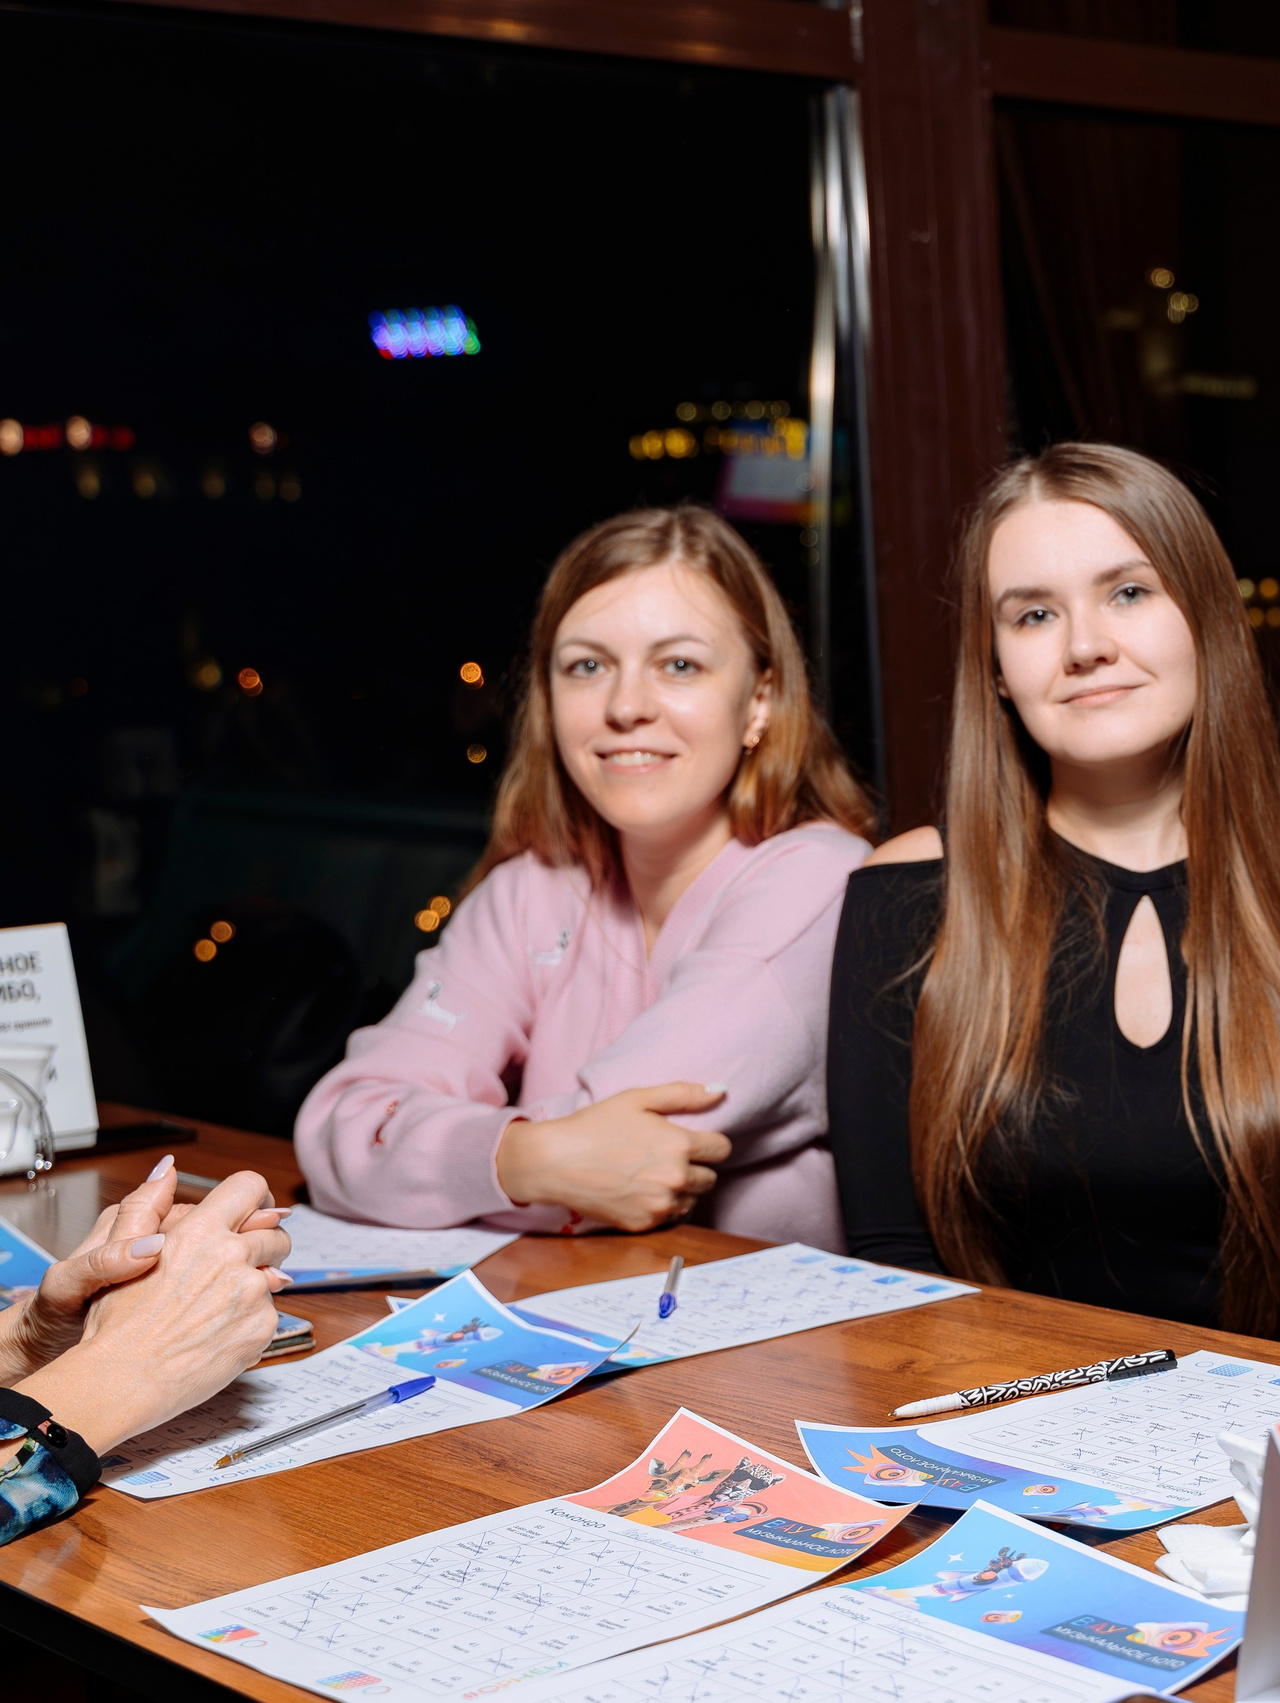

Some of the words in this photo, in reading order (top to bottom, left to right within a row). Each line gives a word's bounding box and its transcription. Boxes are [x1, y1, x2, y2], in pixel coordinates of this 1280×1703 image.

[890, 1447, 920, 1467] ЛОТО
[937, 1476, 980, 1492] ВАУ
[762, 1519, 815, 1535] ВАУ
[745, 1527, 827, 1552] МУЗЫКАЛЬНОЕ
[824, 1547, 858, 1556] ЛОТО
[1070, 1616, 1130, 1635] ВАУ
[1052, 1625, 1151, 1661] МУЗЫКАЛЬНОЕ
[1145, 1656, 1187, 1669] ЛОТО
